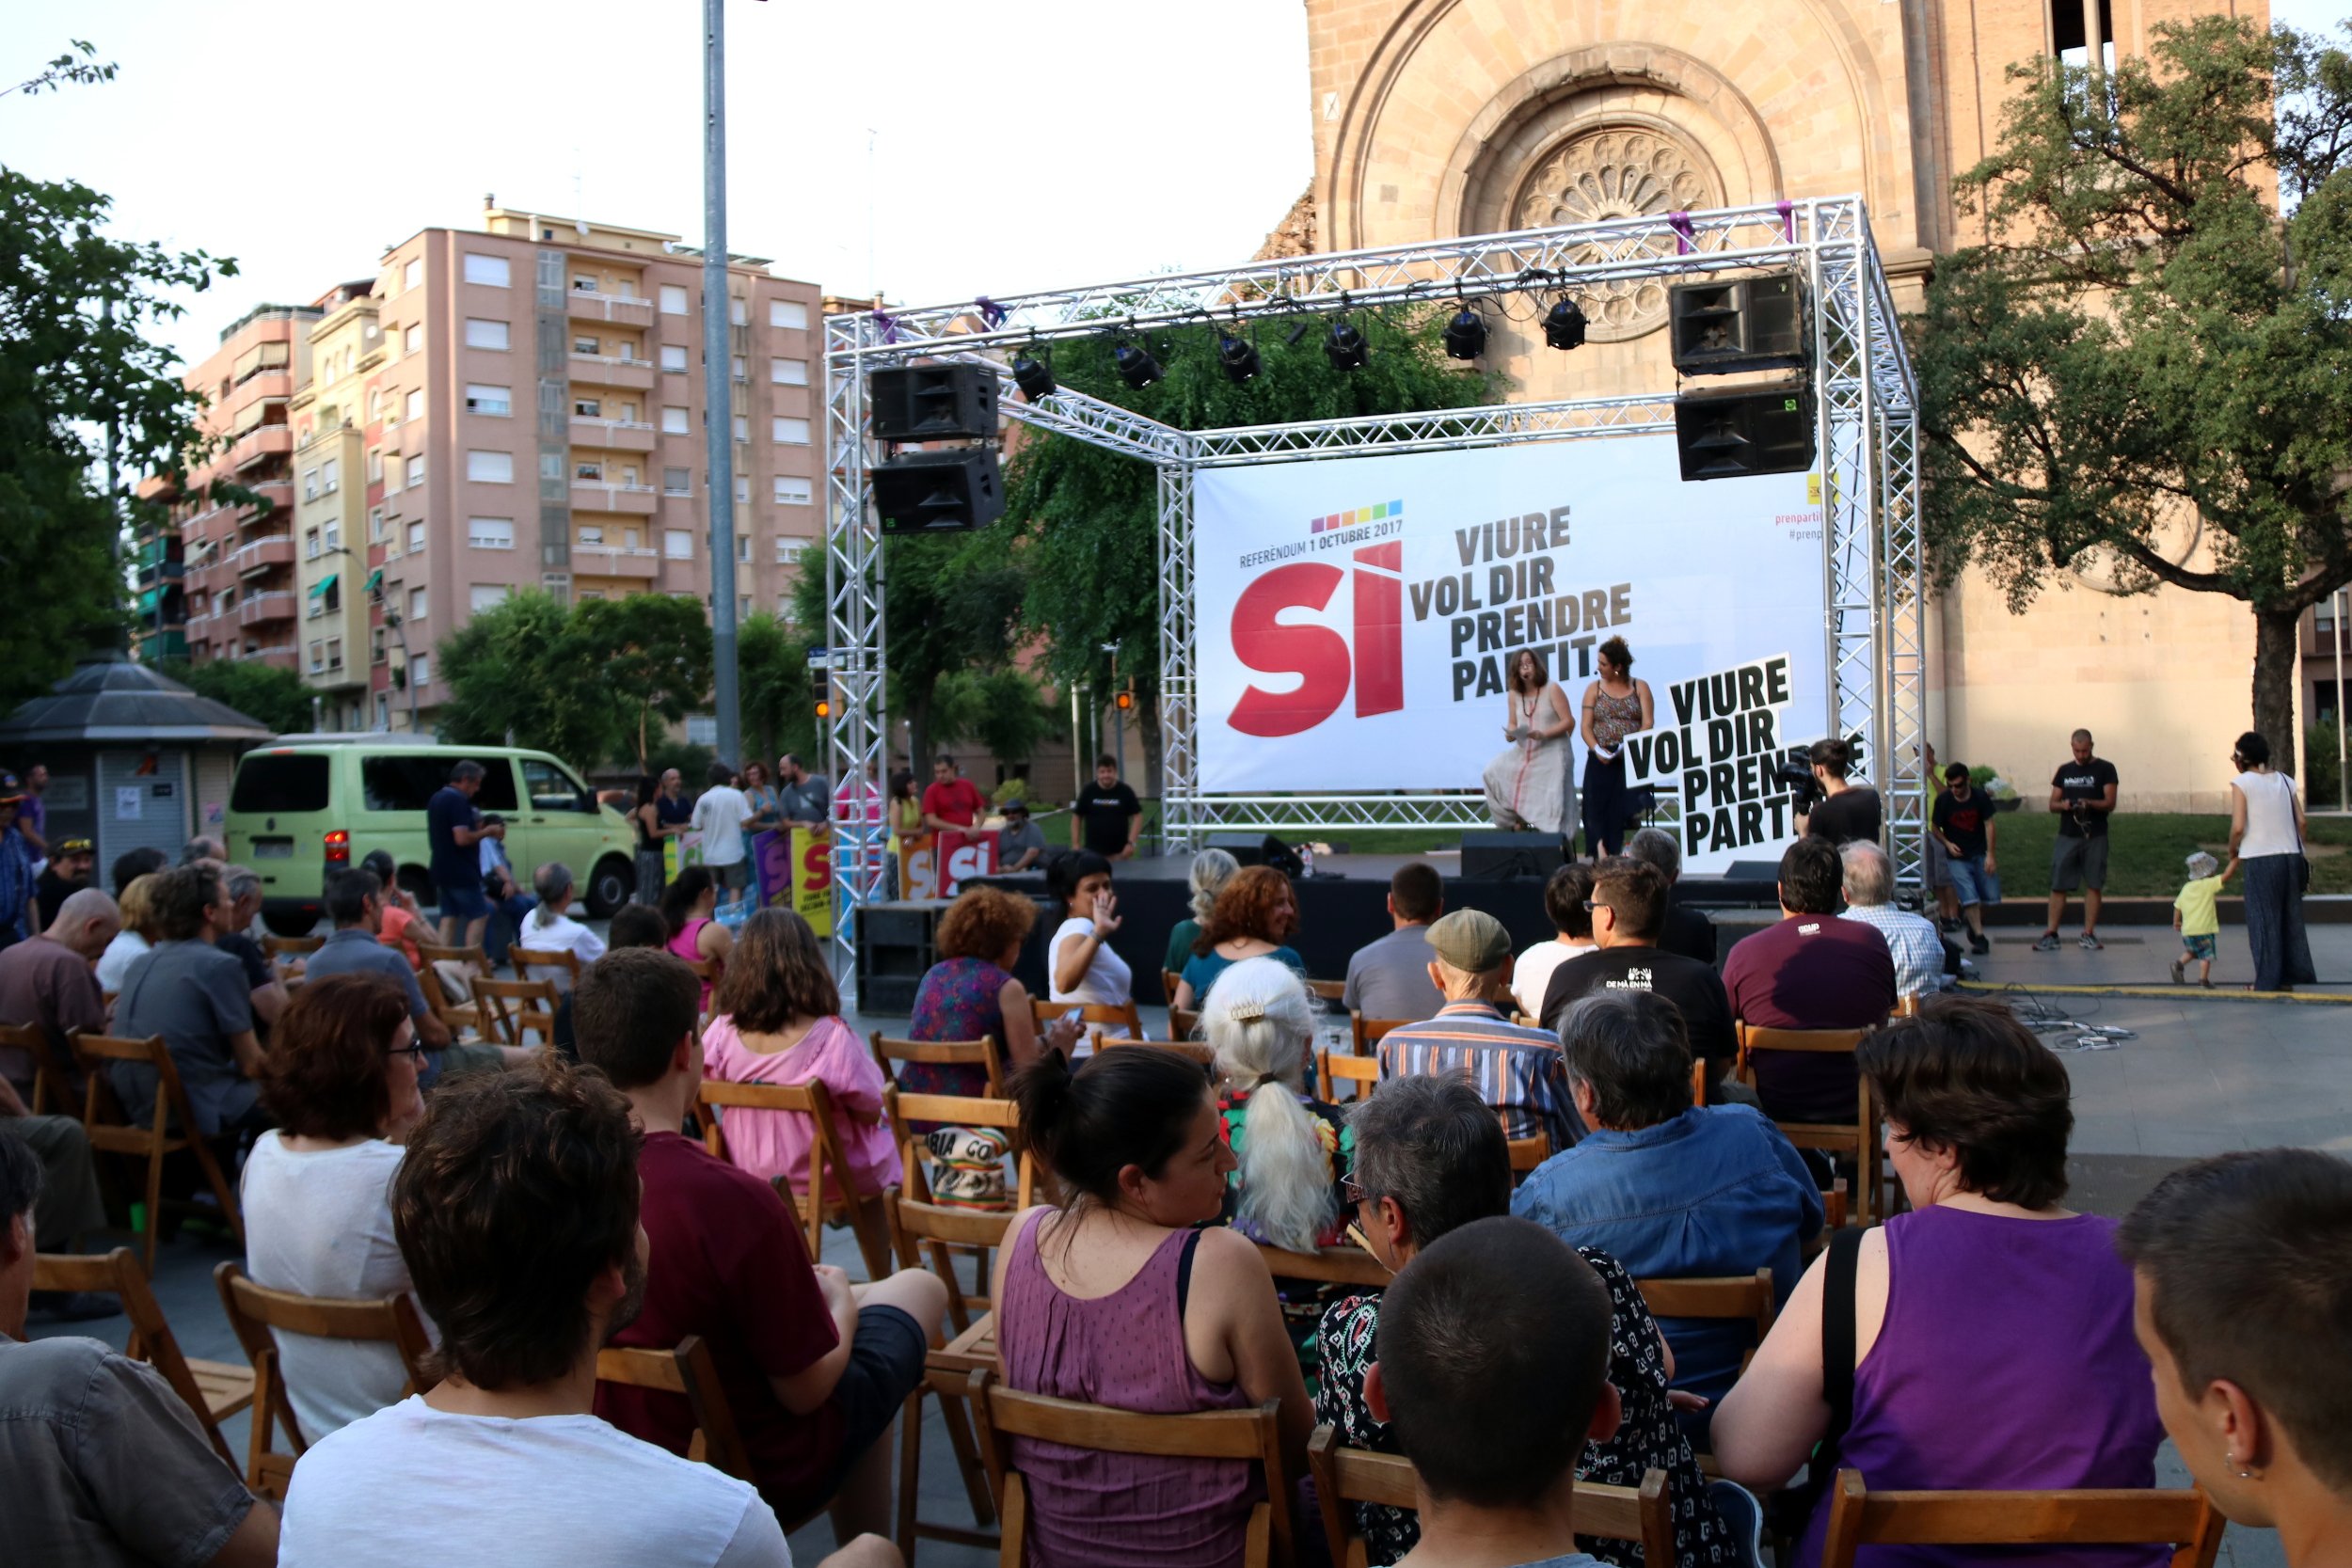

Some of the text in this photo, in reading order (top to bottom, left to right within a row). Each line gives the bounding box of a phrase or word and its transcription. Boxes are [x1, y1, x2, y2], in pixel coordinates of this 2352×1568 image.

[1240, 519, 1404, 569] REFERÈNDUM 1 OCTUBRE 2017
[1454, 505, 1570, 567] VIURE
[1408, 556, 1556, 622] VOL DIR
[1451, 582, 1631, 658] PRENDRE
[1669, 657, 1789, 726] VIURE
[1627, 708, 1776, 780] VOL DIR
[1629, 980, 1640, 989] EN
